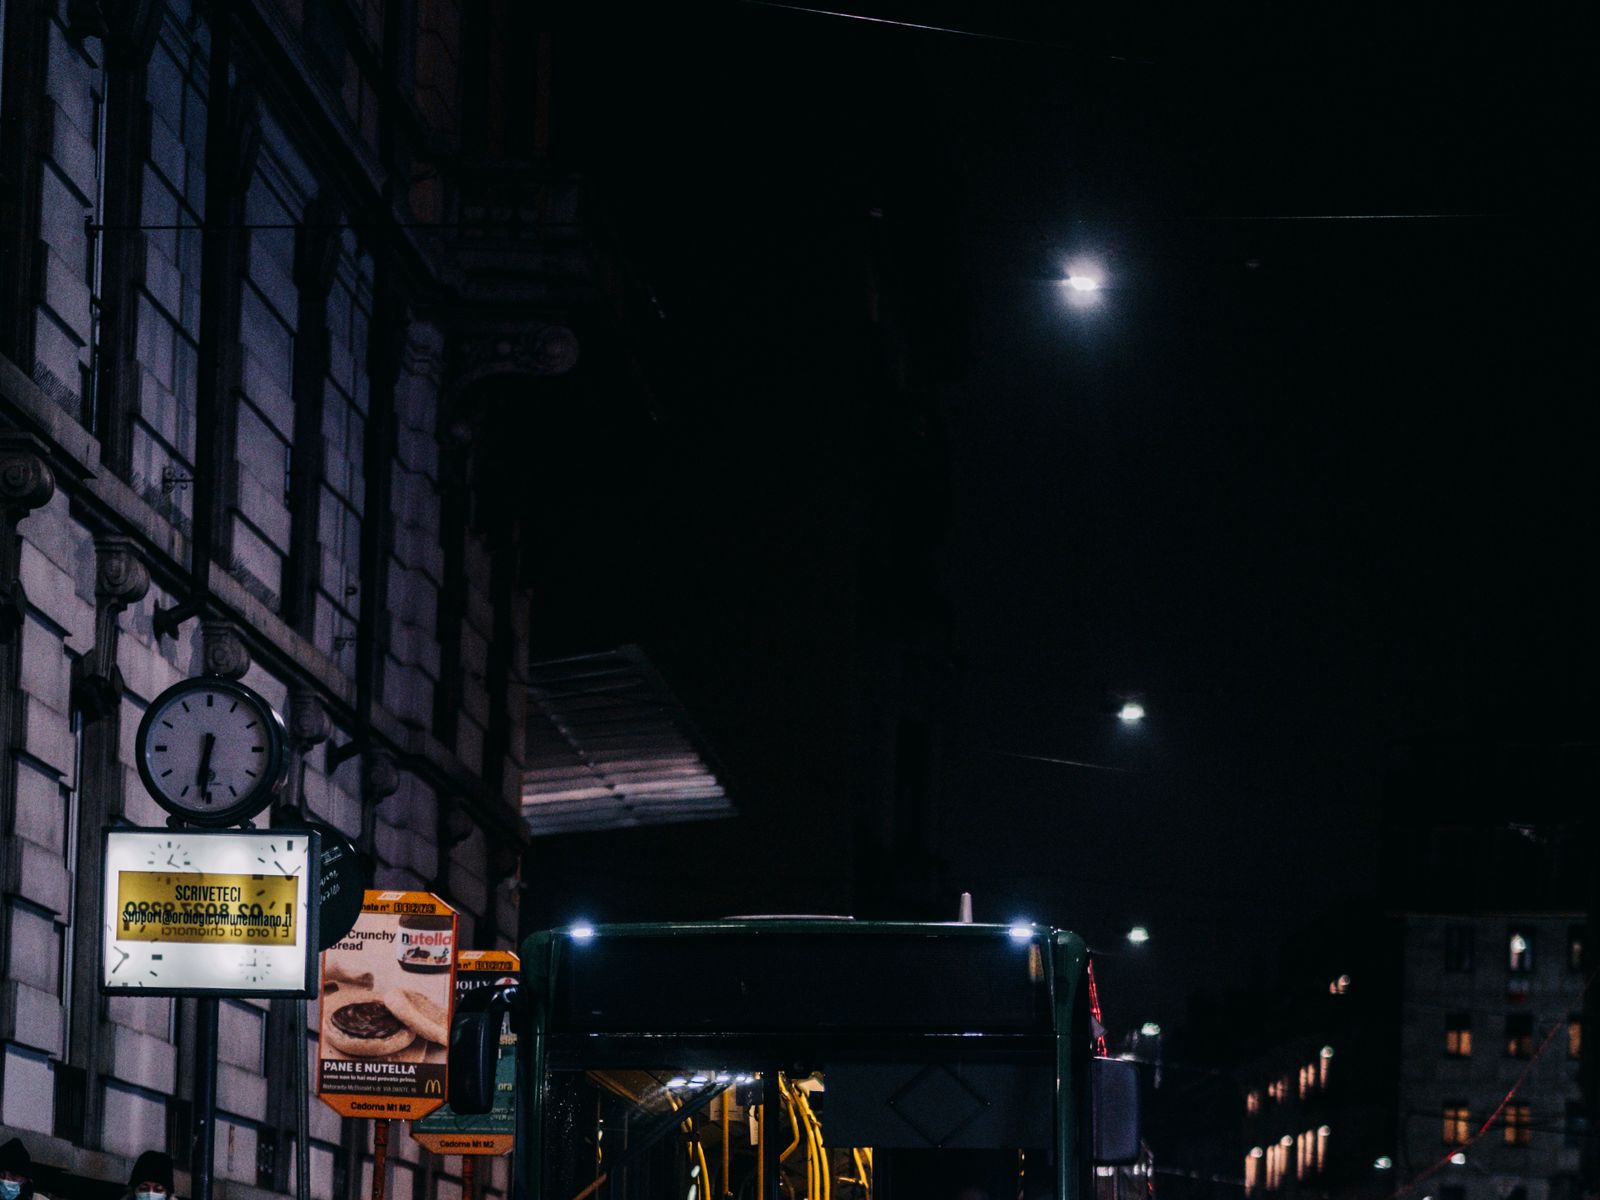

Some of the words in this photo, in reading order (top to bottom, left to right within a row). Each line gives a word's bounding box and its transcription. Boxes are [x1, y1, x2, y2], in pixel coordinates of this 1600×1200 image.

[175, 885, 241, 902] SCRIVETECI
[348, 929, 397, 943] Crunchy
[402, 932, 452, 946] nutella
[323, 1061, 353, 1072] PANE
[355, 1063, 362, 1072] E
[350, 1102, 385, 1111] Cadorna
[387, 1103, 397, 1111] M1
[400, 1104, 411, 1112] M2
[440, 1140, 471, 1148] Cadorna
